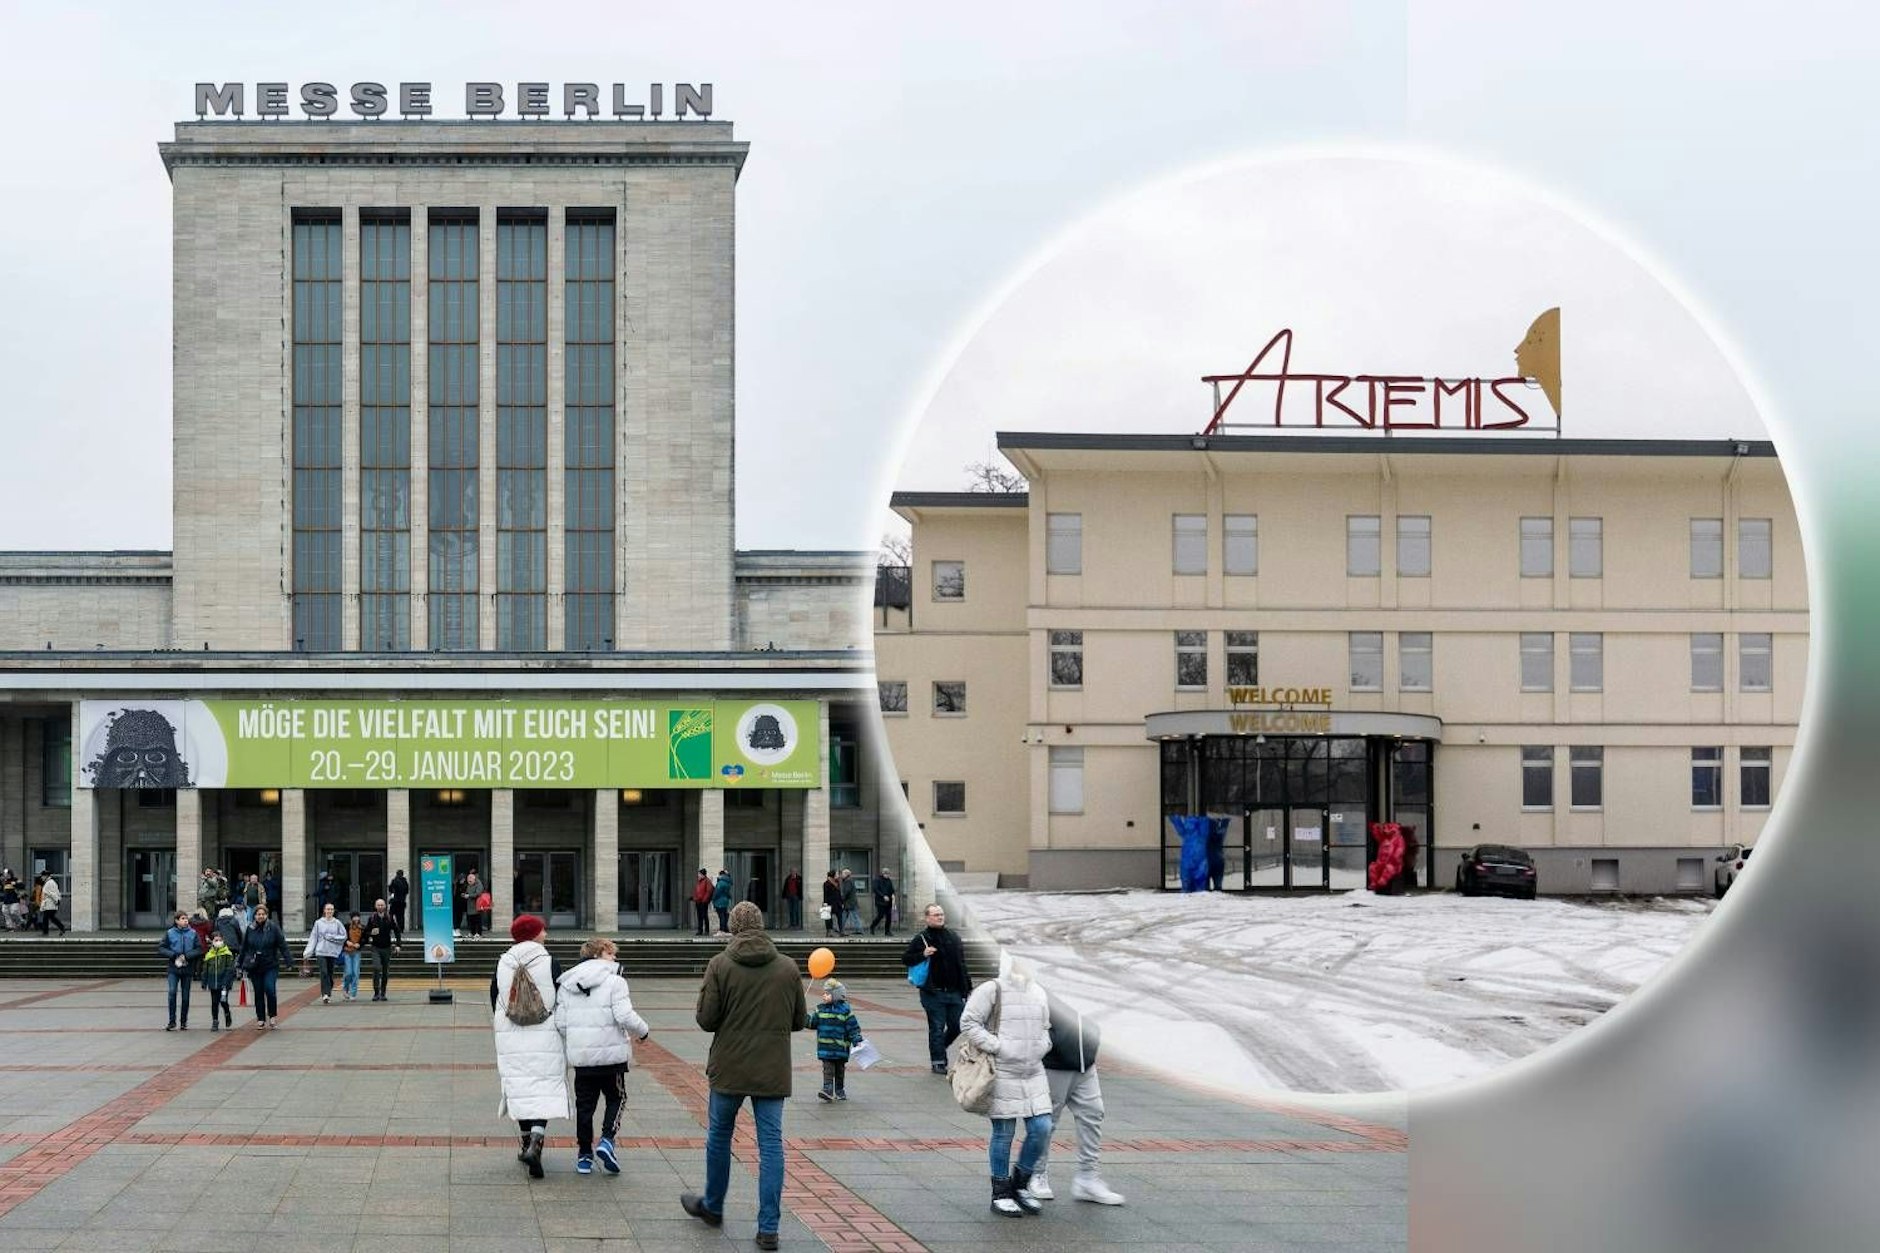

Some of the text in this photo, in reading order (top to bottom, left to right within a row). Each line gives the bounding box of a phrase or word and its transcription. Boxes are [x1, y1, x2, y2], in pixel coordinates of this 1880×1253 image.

[195, 82, 713, 116] MESSE BERLIN
[1229, 687, 1333, 704] WELCOME
[238, 703, 306, 739] MÖGE
[313, 708, 351, 739] DIE
[358, 708, 467, 739] VIELFALT
[473, 708, 517, 739] MIT
[523, 708, 587, 739] EUCH
[593, 708, 656, 739] SEIN!
[1229, 713, 1332, 732] WELCOME
[409, 750, 502, 781] JANUAR
[509, 750, 575, 781] 2023
